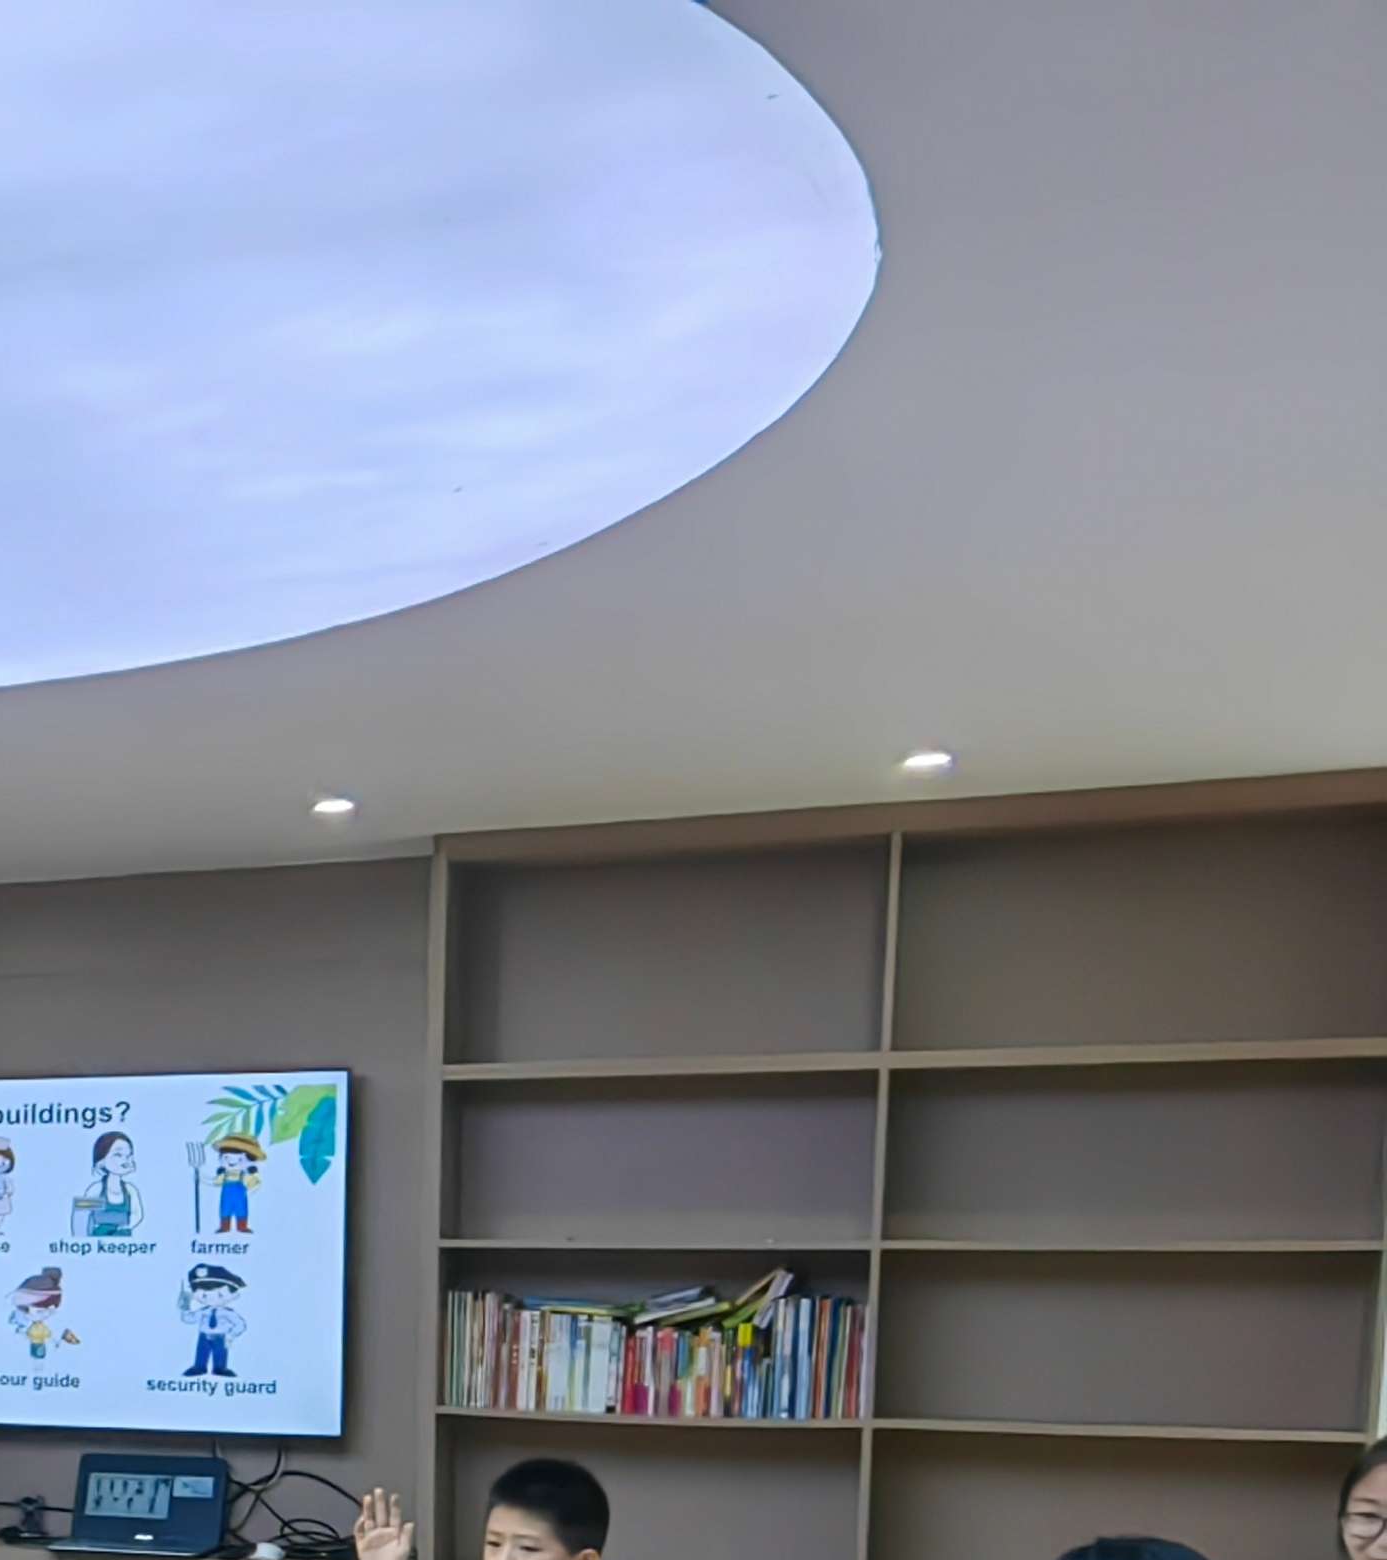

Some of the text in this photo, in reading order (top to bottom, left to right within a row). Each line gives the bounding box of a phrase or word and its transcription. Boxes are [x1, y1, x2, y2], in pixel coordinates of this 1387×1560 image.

[48, 1239, 158, 1257] shop keeper
[190, 1239, 250, 1254] farmer
[32, 1374, 81, 1391] guide
[146, 1378, 277, 1397] security guard
